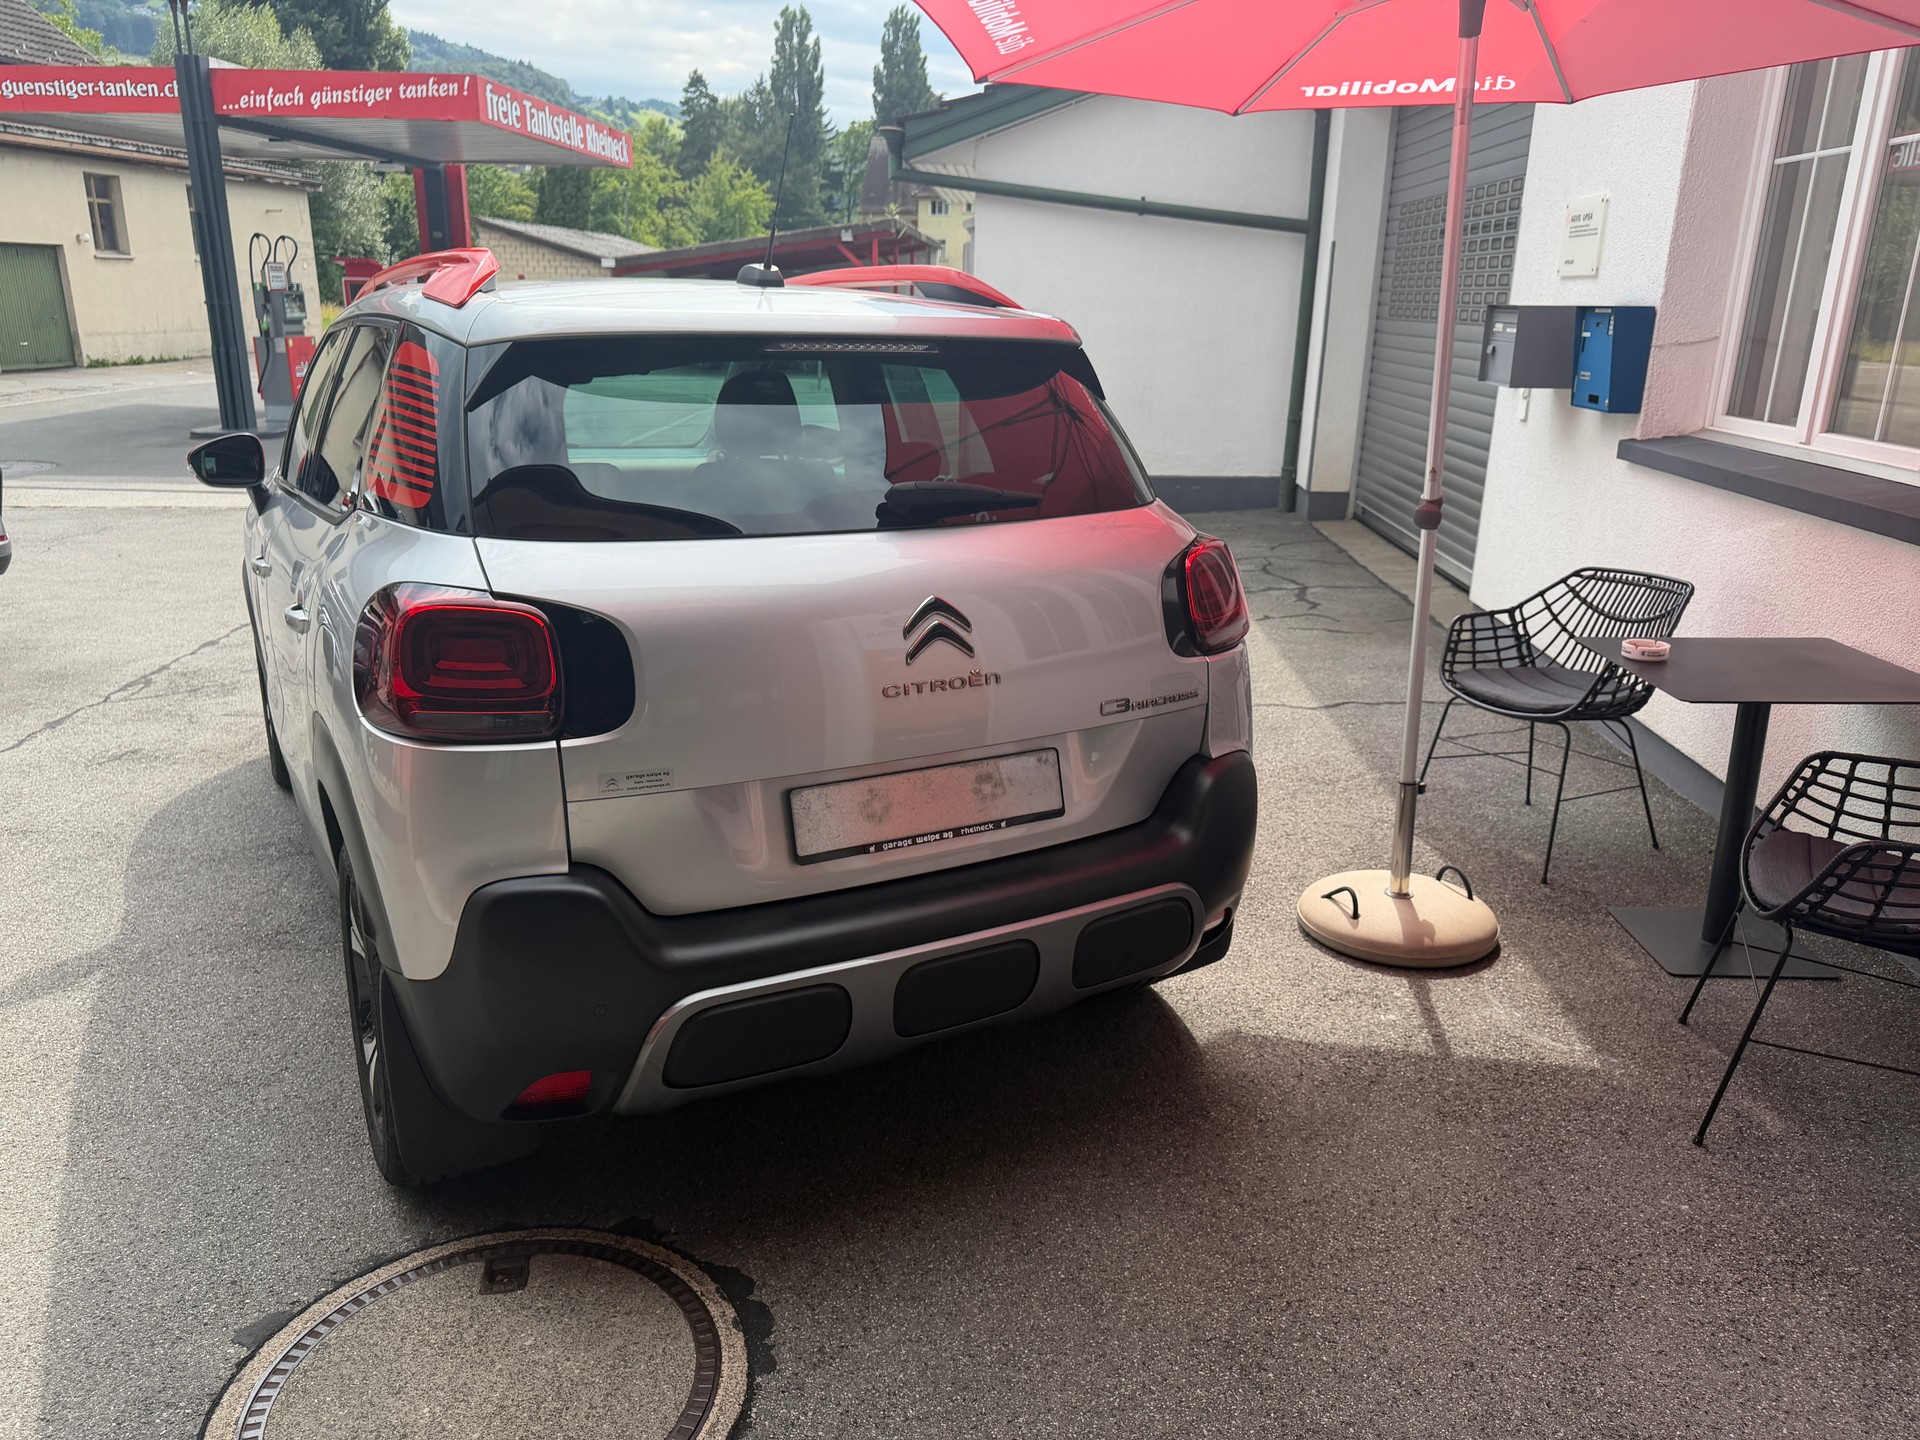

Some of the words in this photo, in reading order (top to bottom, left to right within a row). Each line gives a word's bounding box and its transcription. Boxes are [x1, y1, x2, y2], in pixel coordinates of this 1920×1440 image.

[310, 83, 393, 110] günstiger
[399, 76, 458, 99] tanken
[485, 83, 521, 129] freie
[522, 99, 585, 149] Tankstelle
[585, 123, 630, 164] Rheineck
[882, 839, 913, 851] garage
[942, 831, 953, 839] ag
[961, 823, 994, 835] rheineck
